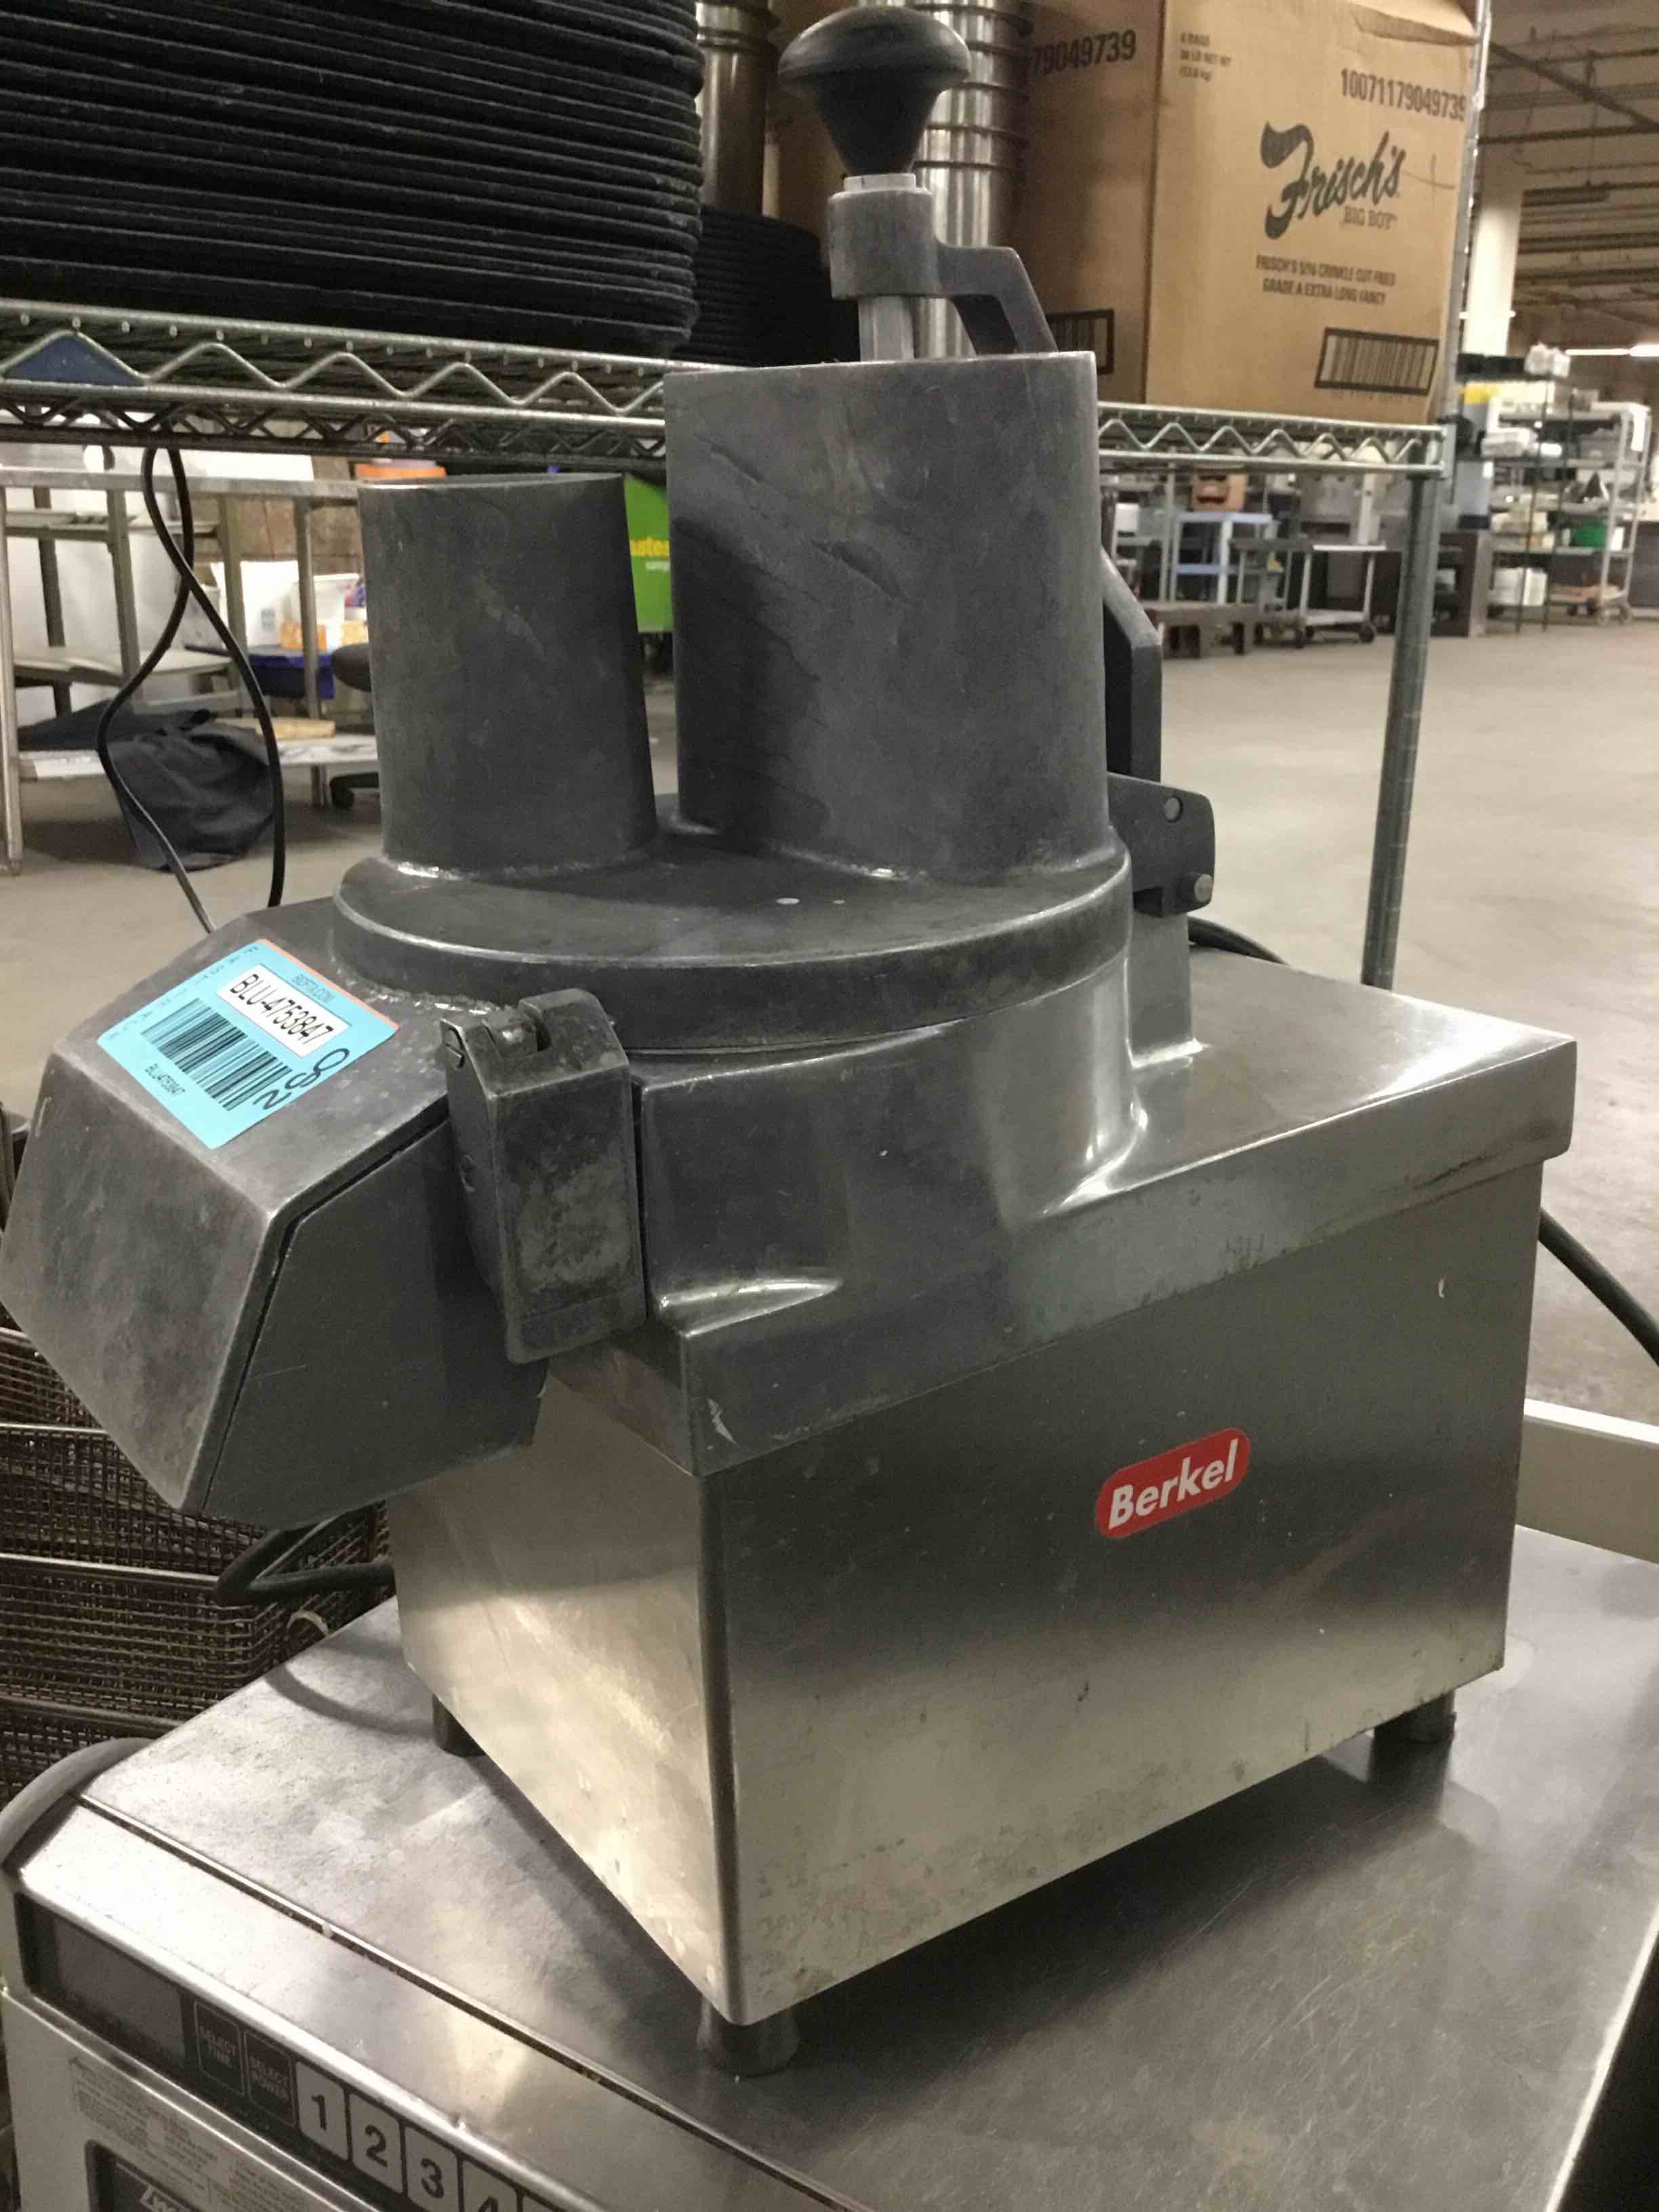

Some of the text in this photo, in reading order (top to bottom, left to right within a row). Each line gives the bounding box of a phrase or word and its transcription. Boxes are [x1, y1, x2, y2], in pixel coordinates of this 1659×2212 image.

[1341, 68, 1466, 122] 10071179049739
[1261, 121, 1406, 240] Frisch's
[1343, 206, 1365, 226] BIG
[1263, 277, 1294, 295] GRADE
[1295, 281, 1303, 295] A
[1304, 282, 1332, 299] EXTRA
[1335, 285, 1357, 302] LONG
[230, 974, 335, 1046] BLU-4753847
[1109, 1438, 1239, 1530] Berkel
[311, 2094, 327, 2131] 1
[364, 2125, 388, 2167] 2
[420, 2158, 445, 2198] 3
